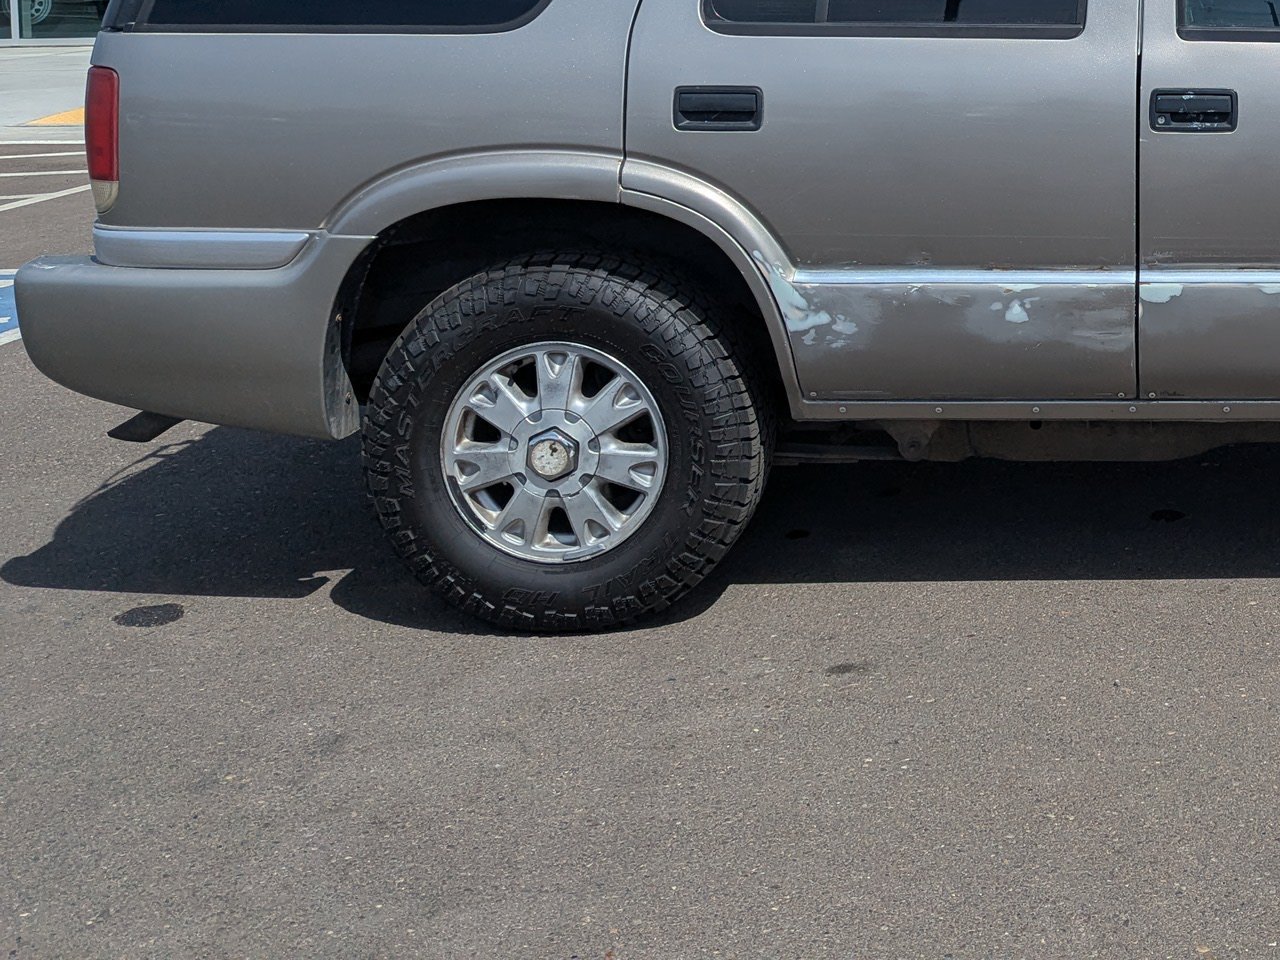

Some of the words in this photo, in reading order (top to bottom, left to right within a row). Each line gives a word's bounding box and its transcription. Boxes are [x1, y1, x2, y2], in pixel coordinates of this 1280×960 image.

[395, 304, 587, 499] MASTERCRAFT
[640, 343, 705, 517] COURSER
[502, 587, 561, 606] HD
